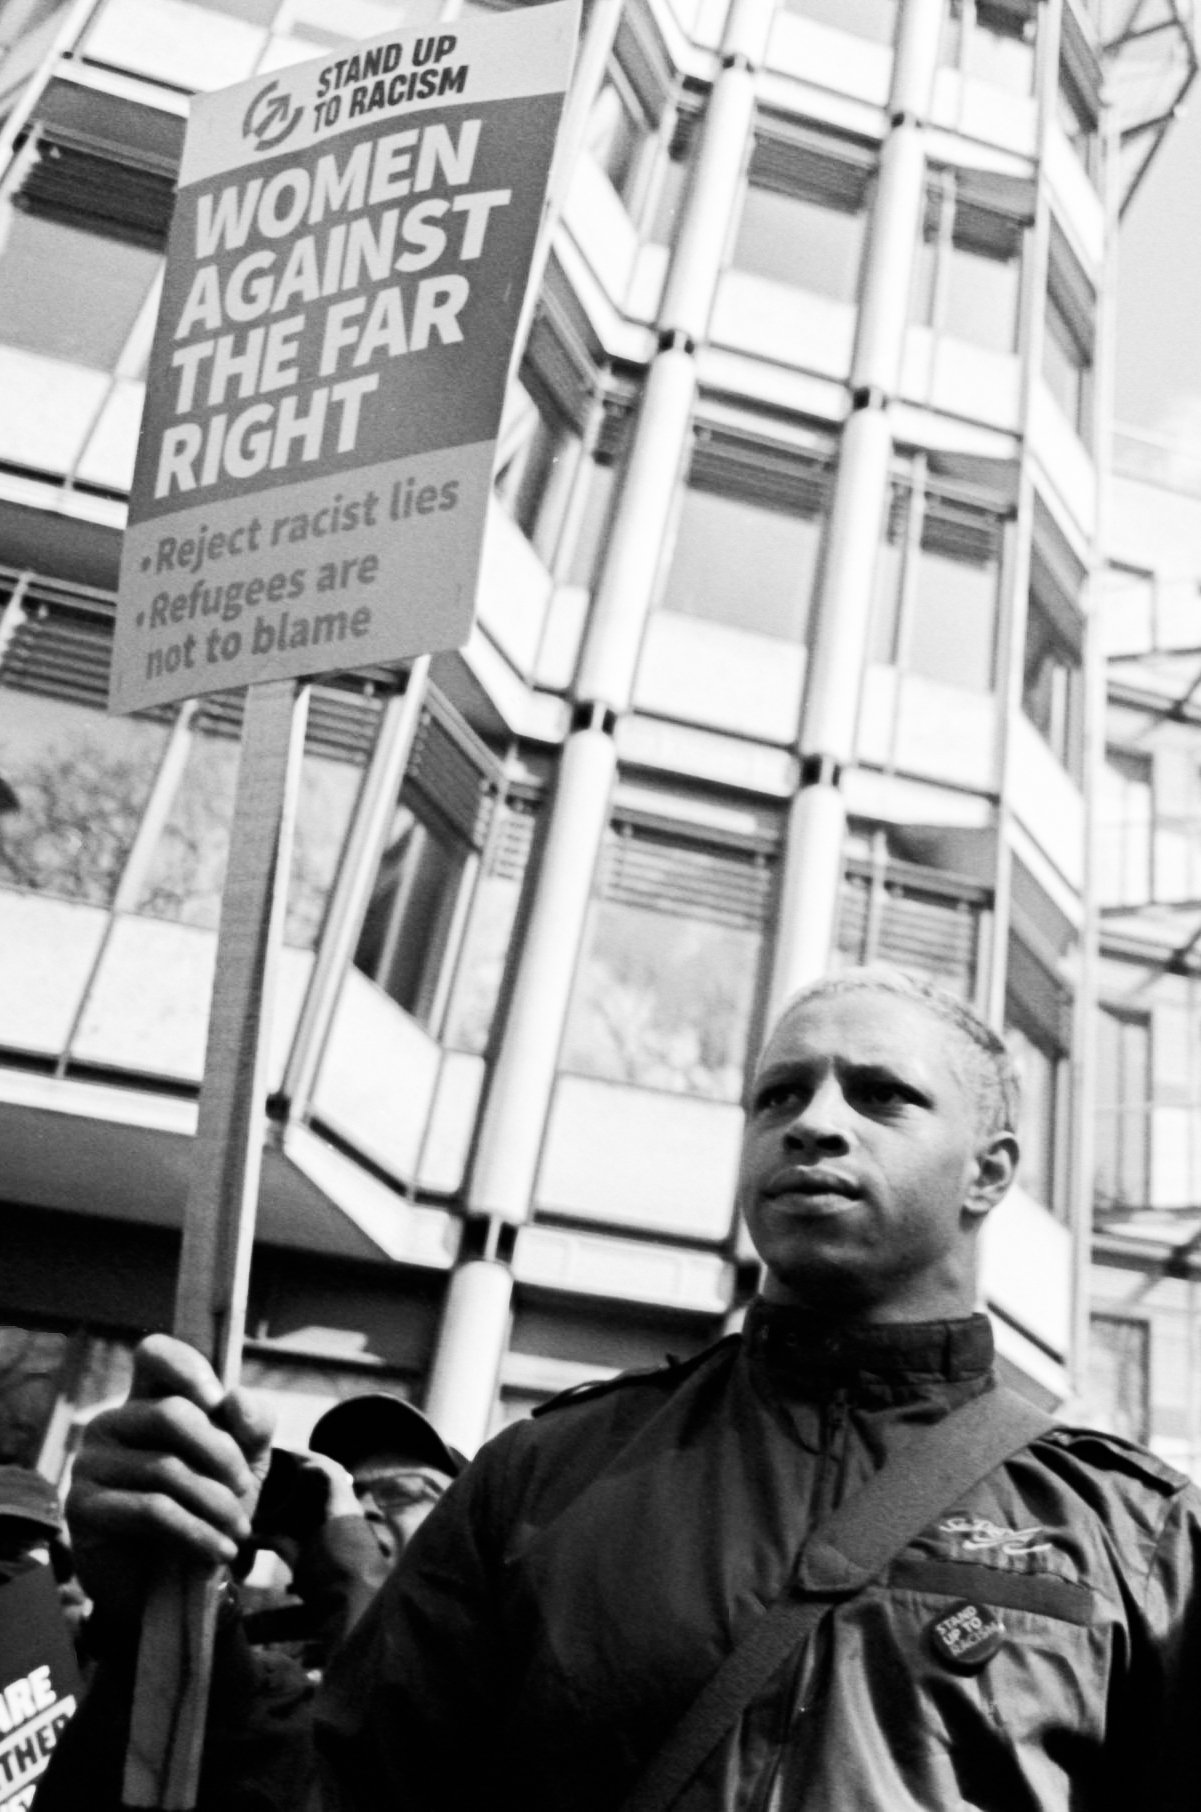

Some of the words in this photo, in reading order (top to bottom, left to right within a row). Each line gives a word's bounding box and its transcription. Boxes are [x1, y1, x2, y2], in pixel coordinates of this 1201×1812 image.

[314, 94, 340, 133] TO
[349, 65, 469, 118] RACISM
[317, 43, 402, 97] STAND
[412, 35, 458, 66] UP
[196, 119, 482, 259] WOMEN
[174, 189, 512, 339] AGAINST
[172, 314, 305, 415] THE
[319, 274, 470, 377] FAR
[154, 373, 380, 499] RIGHT
[271, 494, 378, 546] racist
[391, 477, 460, 523] lies
[316, 553, 380, 593] are
[146, 634, 197, 680] not
[206, 625, 242, 664] to
[251, 606, 372, 657] blame
